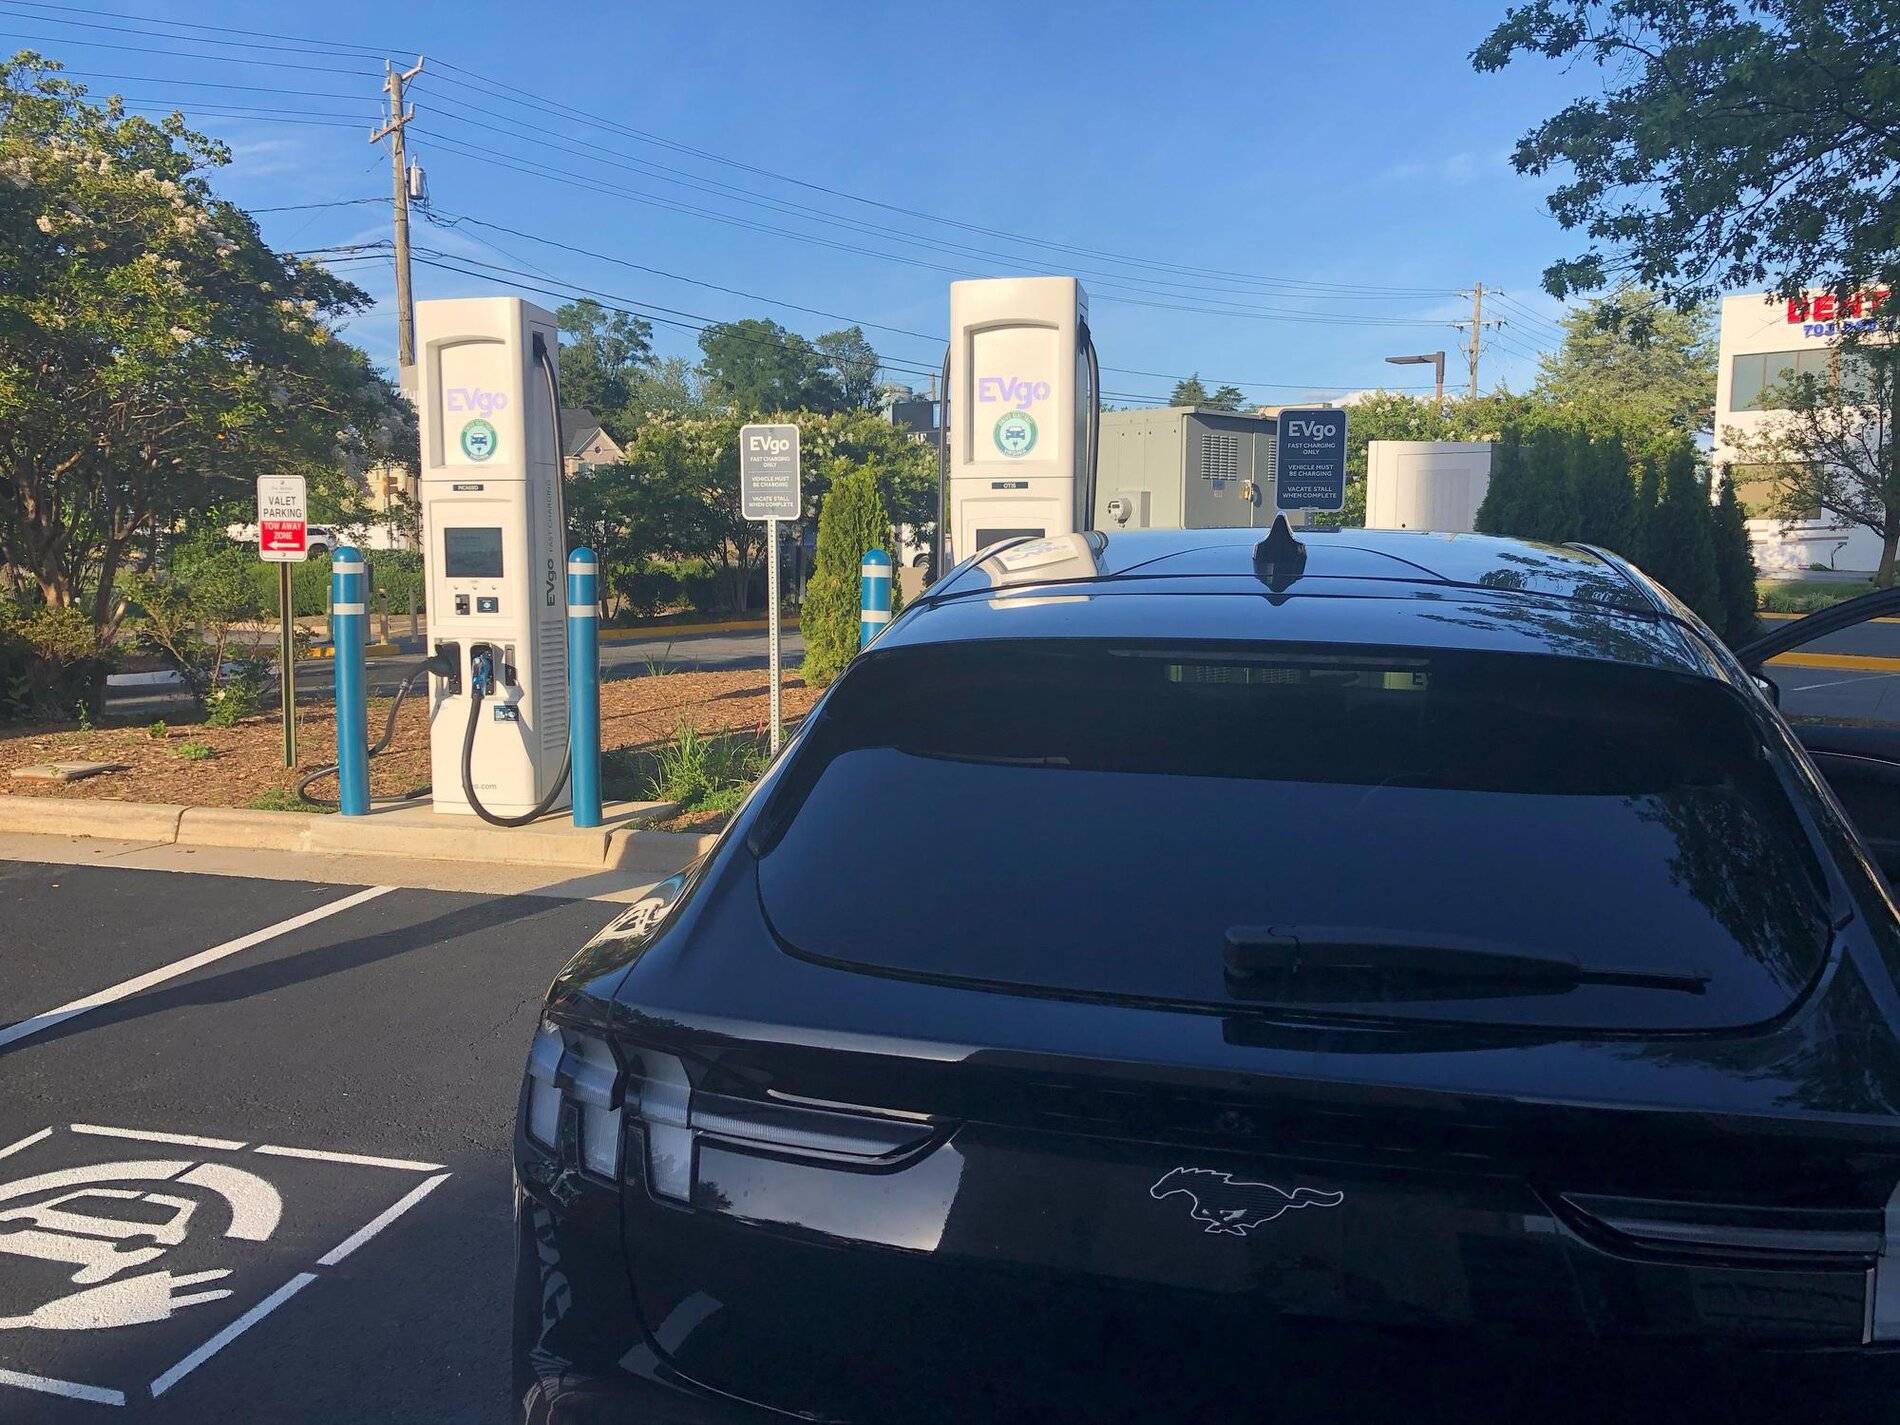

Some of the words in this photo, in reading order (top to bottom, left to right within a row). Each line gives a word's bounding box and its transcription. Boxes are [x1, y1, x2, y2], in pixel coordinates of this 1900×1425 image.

[978, 377, 1051, 409] EVgo
[447, 388, 508, 417] EVgo
[1288, 420, 1336, 441] EVgo
[750, 436, 790, 454] EVgo
[268, 496, 296, 506] VALET
[263, 508, 302, 518] PARKING
[264, 522, 280, 530] TOW
[281, 522, 302, 530] AWAY
[273, 531, 293, 540] ZONE
[546, 558, 557, 607] EVgo
